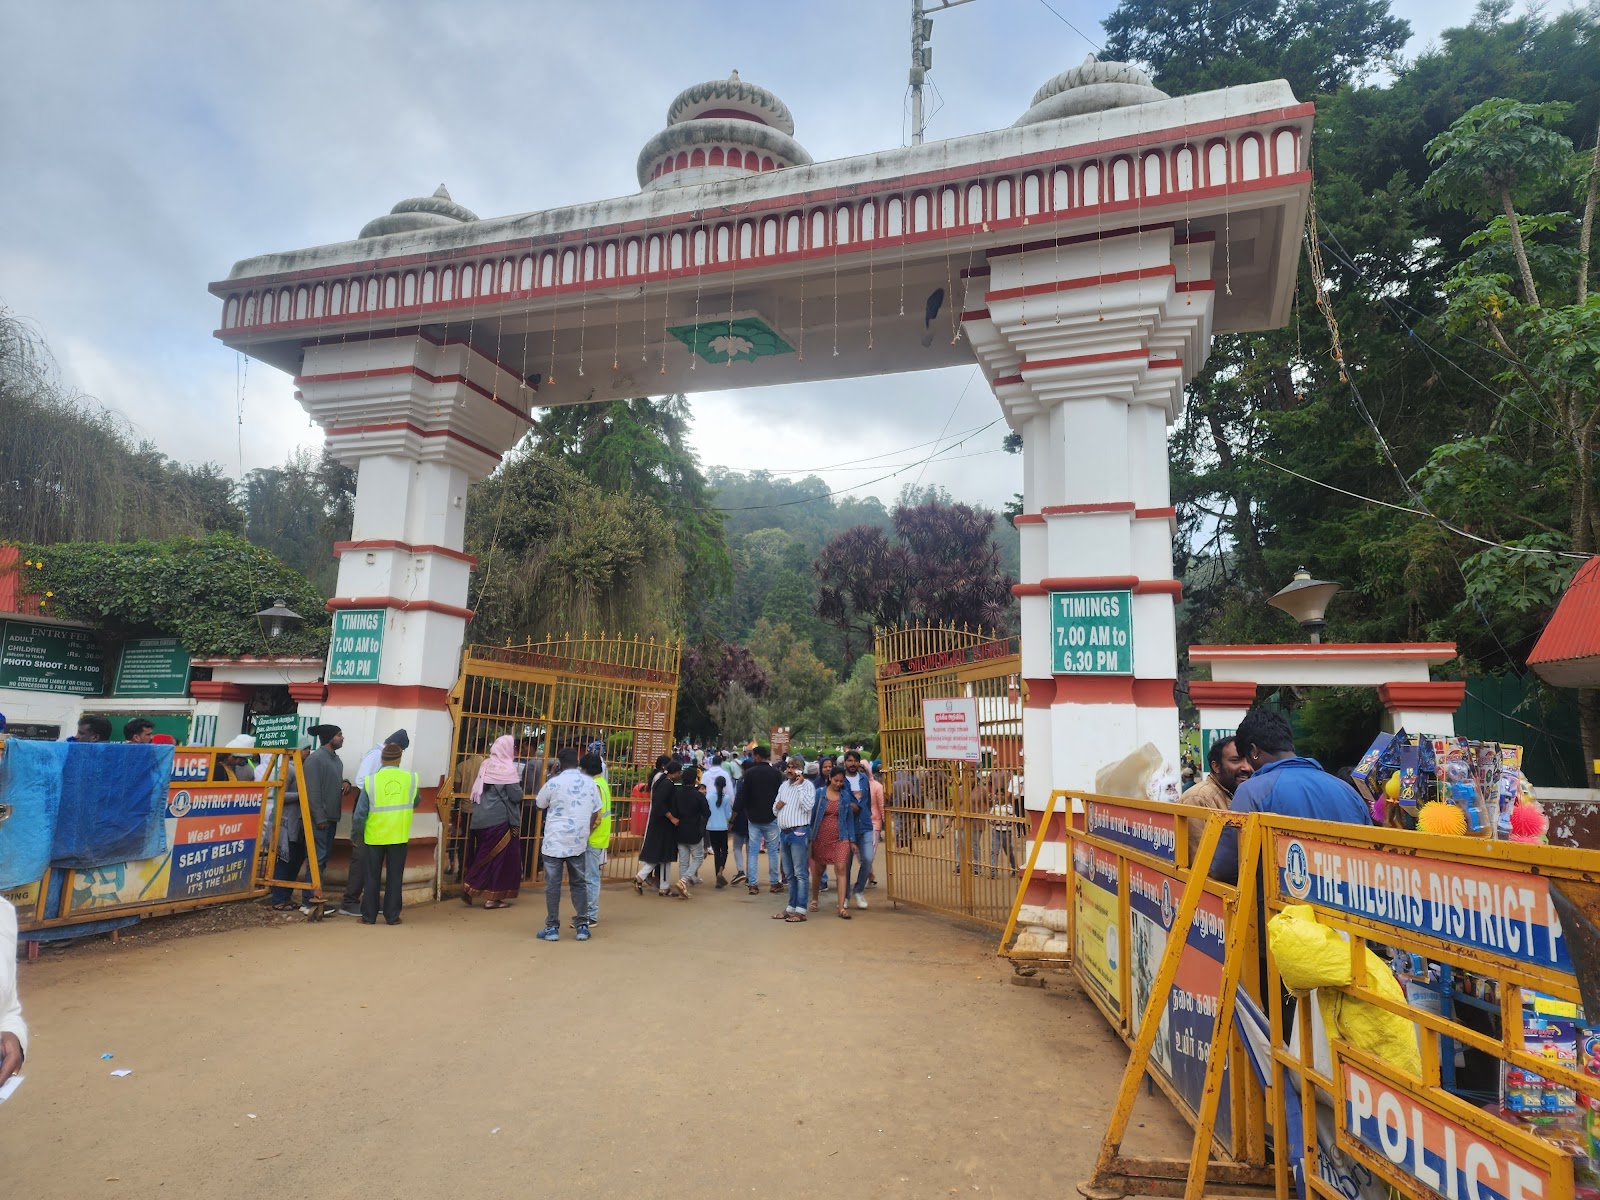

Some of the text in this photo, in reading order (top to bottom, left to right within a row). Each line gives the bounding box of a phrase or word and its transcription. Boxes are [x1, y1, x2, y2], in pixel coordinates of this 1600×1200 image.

[1061, 596, 1120, 617] TIMINGS
[342, 614, 379, 630] TIMINGS
[9, 635, 34, 643] ADULT
[31, 627, 89, 642] ENTRY FEE
[1057, 626, 1127, 646] 7.00 AM to
[7, 645, 47, 654] CHILDREN
[336, 637, 379, 653] 7.00 AM to
[2, 658, 32, 667] PHOTO
[34, 661, 63, 670] SHOOT
[84, 665, 100, 673] 1000
[336, 660, 371, 676] 6.30 PM
[1064, 651, 1118, 671] 6.30 PM
[171, 758, 207, 777] LICE
[192, 793, 263, 810] DISTRICT POLICE
[187, 823, 243, 844] Wear Your
[1132, 817, 1175, 855] காவல்துறை
[179, 840, 245, 868] SEAT BELTS
[186, 871, 202, 884] IT'S
[203, 865, 224, 879] YOUR
[226, 860, 242, 872] LIFE
[187, 881, 203, 895] IT'S
[205, 876, 221, 889] THE
[222, 872, 239, 884] LAW
[1314, 851, 1344, 905] THE
[1347, 858, 1424, 928] NILGIRIS
[1430, 872, 1536, 957] DISTRICT
[1172, 989, 1218, 1018] தலை கவச
